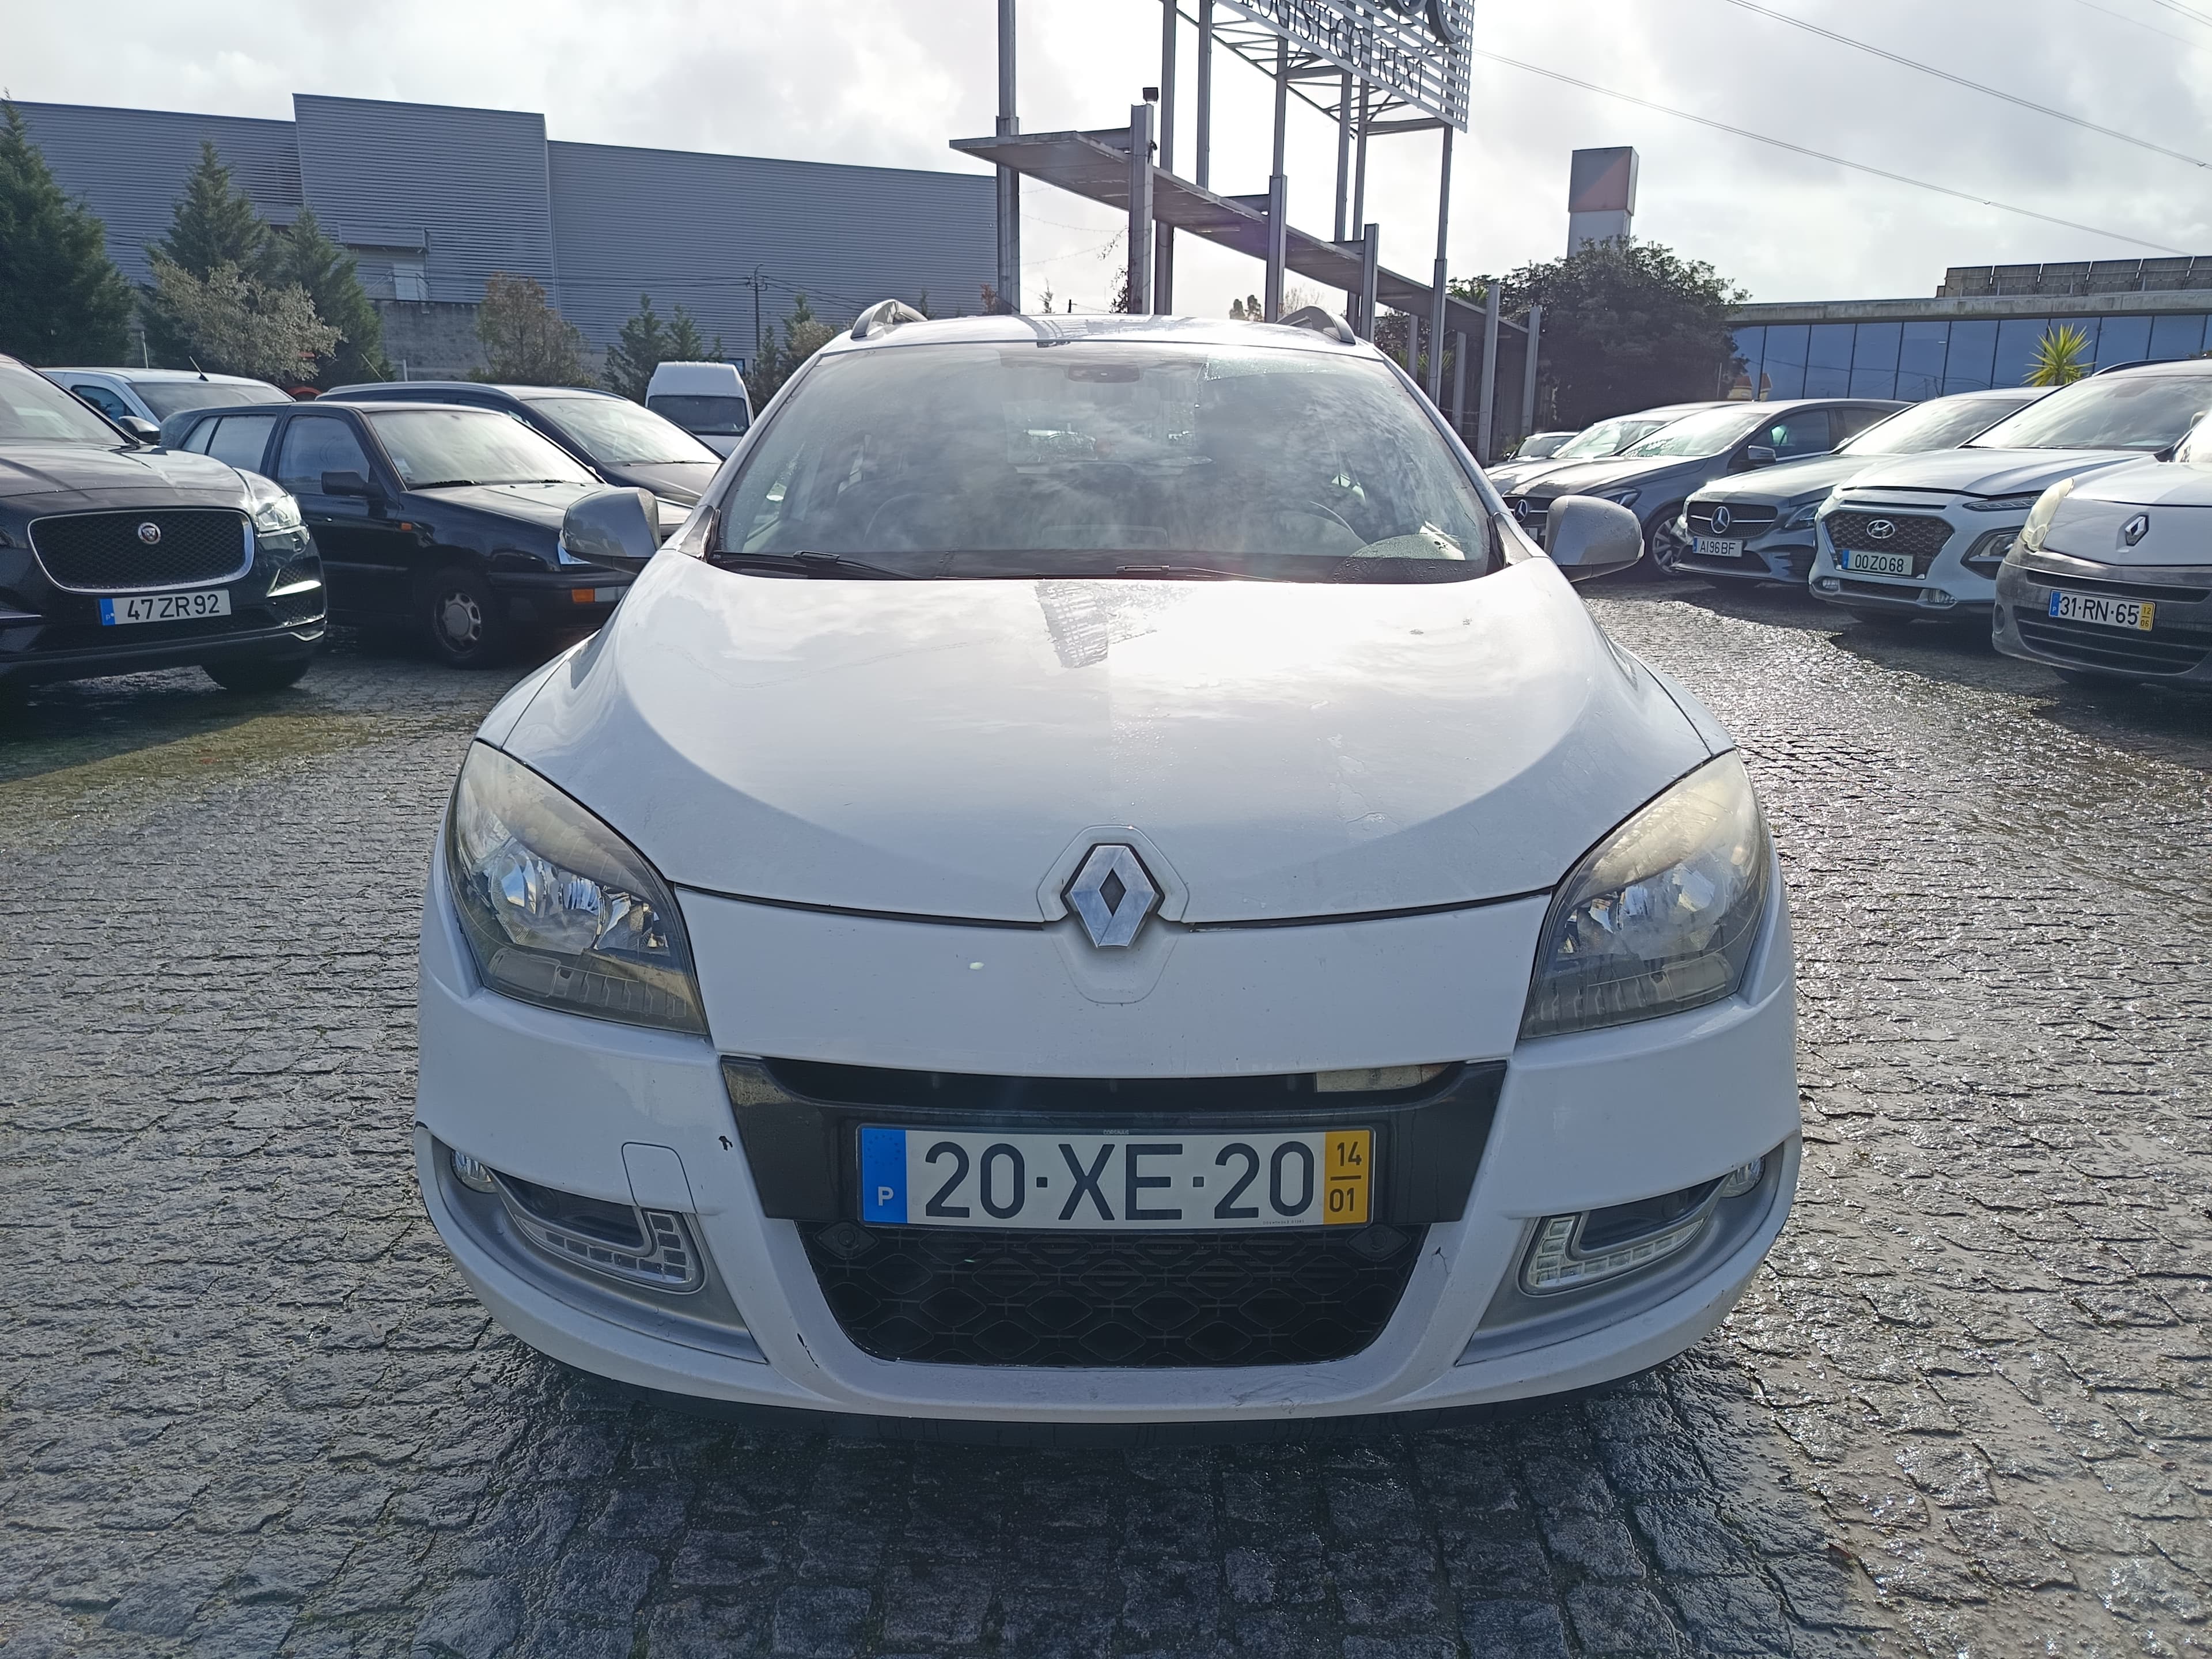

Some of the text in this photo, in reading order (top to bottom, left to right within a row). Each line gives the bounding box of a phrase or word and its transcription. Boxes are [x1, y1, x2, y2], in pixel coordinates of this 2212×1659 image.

[1700, 540, 1736, 555] AI96BF
[1855, 554, 1904, 573] 00ZO68
[2142, 607, 2152, 615] 12
[2140, 619, 2149, 627] 06
[1337, 1141, 1362, 1166] 14
[878, 1186, 894, 1206] P
[1329, 1187, 1354, 1213] 01
